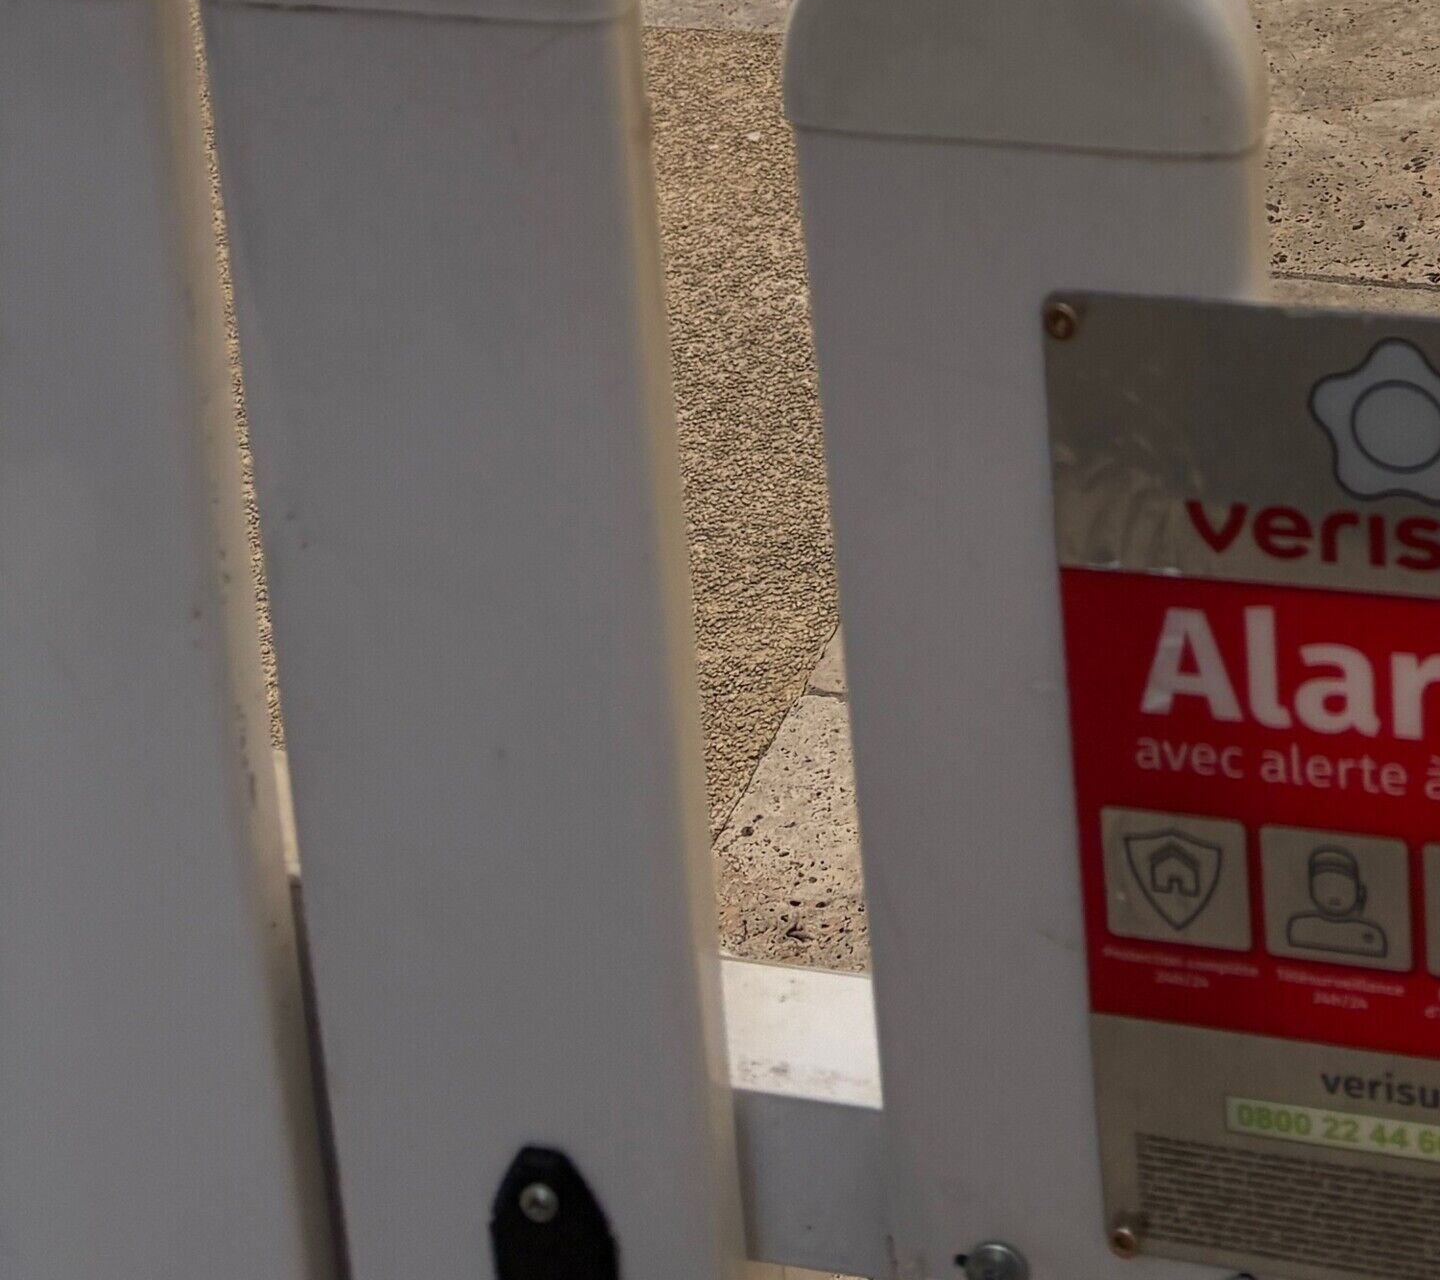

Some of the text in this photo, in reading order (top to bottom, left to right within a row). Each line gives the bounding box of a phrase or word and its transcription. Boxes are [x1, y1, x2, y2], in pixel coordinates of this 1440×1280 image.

[1135, 738, 1244, 780] avec
[1259, 745, 1408, 796] alerte
[1237, 1103, 1312, 1136] 0800
[1323, 1115, 1359, 1141] 22
[1369, 1123, 1409, 1151] 44
